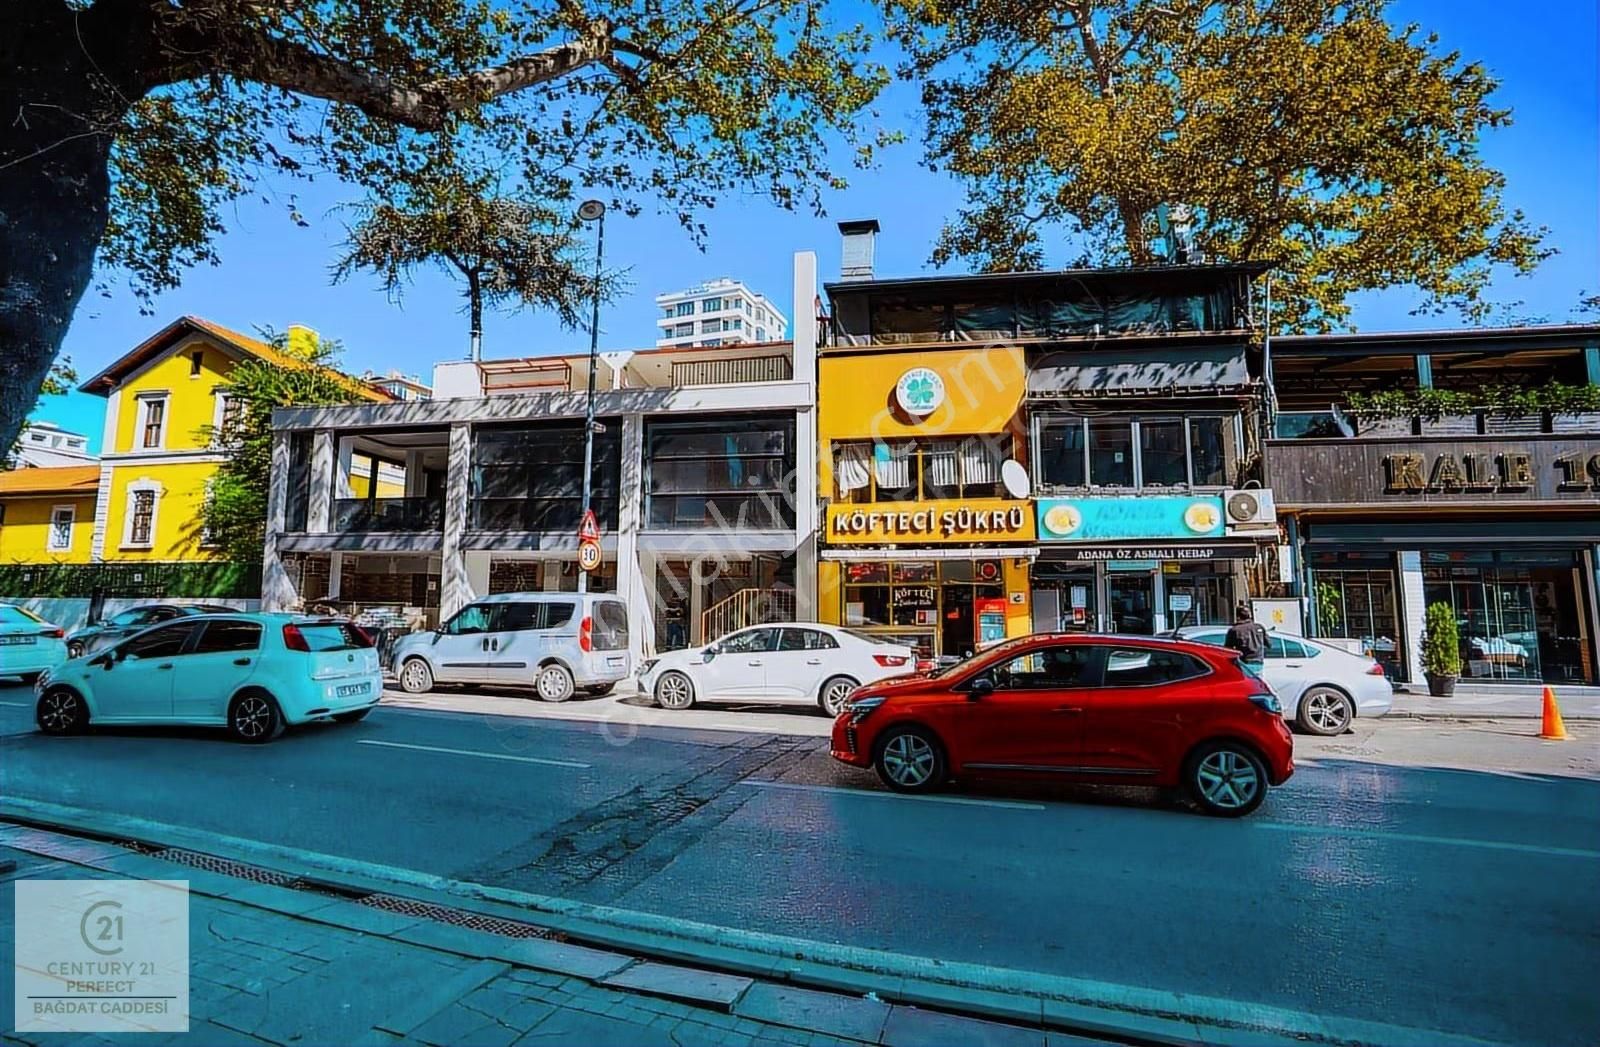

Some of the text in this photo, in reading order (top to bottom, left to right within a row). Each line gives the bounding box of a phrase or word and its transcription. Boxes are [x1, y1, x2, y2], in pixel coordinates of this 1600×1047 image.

[1382, 452, 1535, 495] KALE
[835, 505, 1025, 535] KÖFTECİ ŞÜKRÜ
[583, 548, 596, 561] 30
[1077, 548, 1214, 560] ADANA ÖZ ASMALI KEBAP
